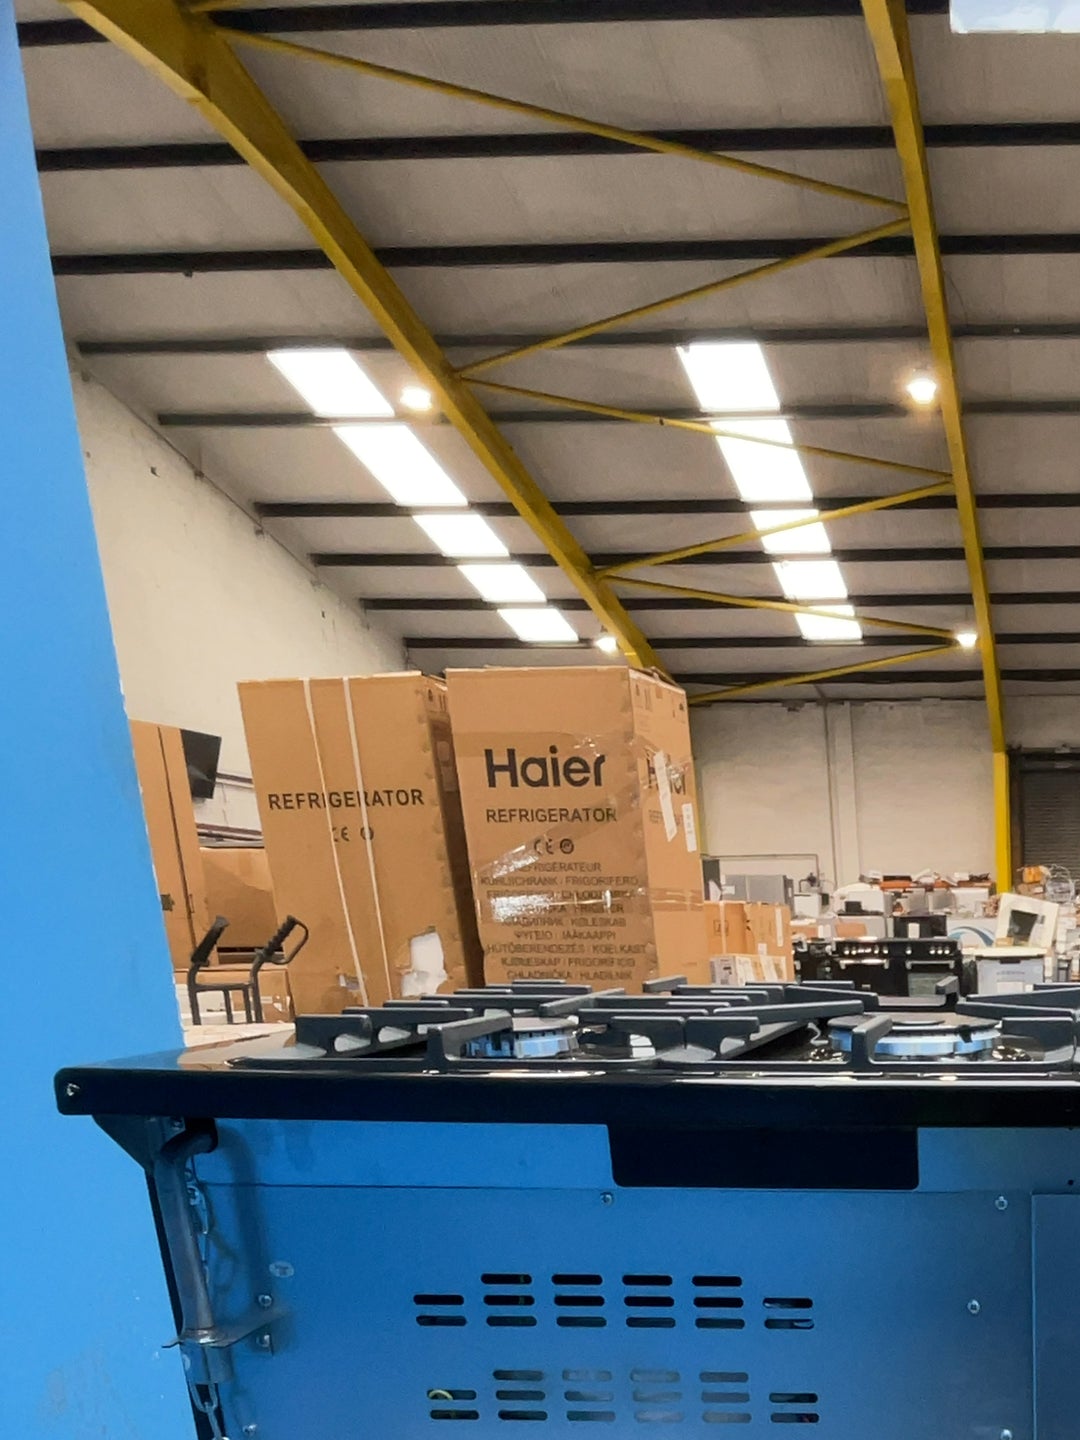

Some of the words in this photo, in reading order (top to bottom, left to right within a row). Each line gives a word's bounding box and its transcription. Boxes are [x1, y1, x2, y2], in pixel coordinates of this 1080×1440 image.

[484, 745, 606, 788] Haier
[268, 789, 425, 810] REFRIGERATOR
[486, 808, 617, 823] REFRIGERATOR
